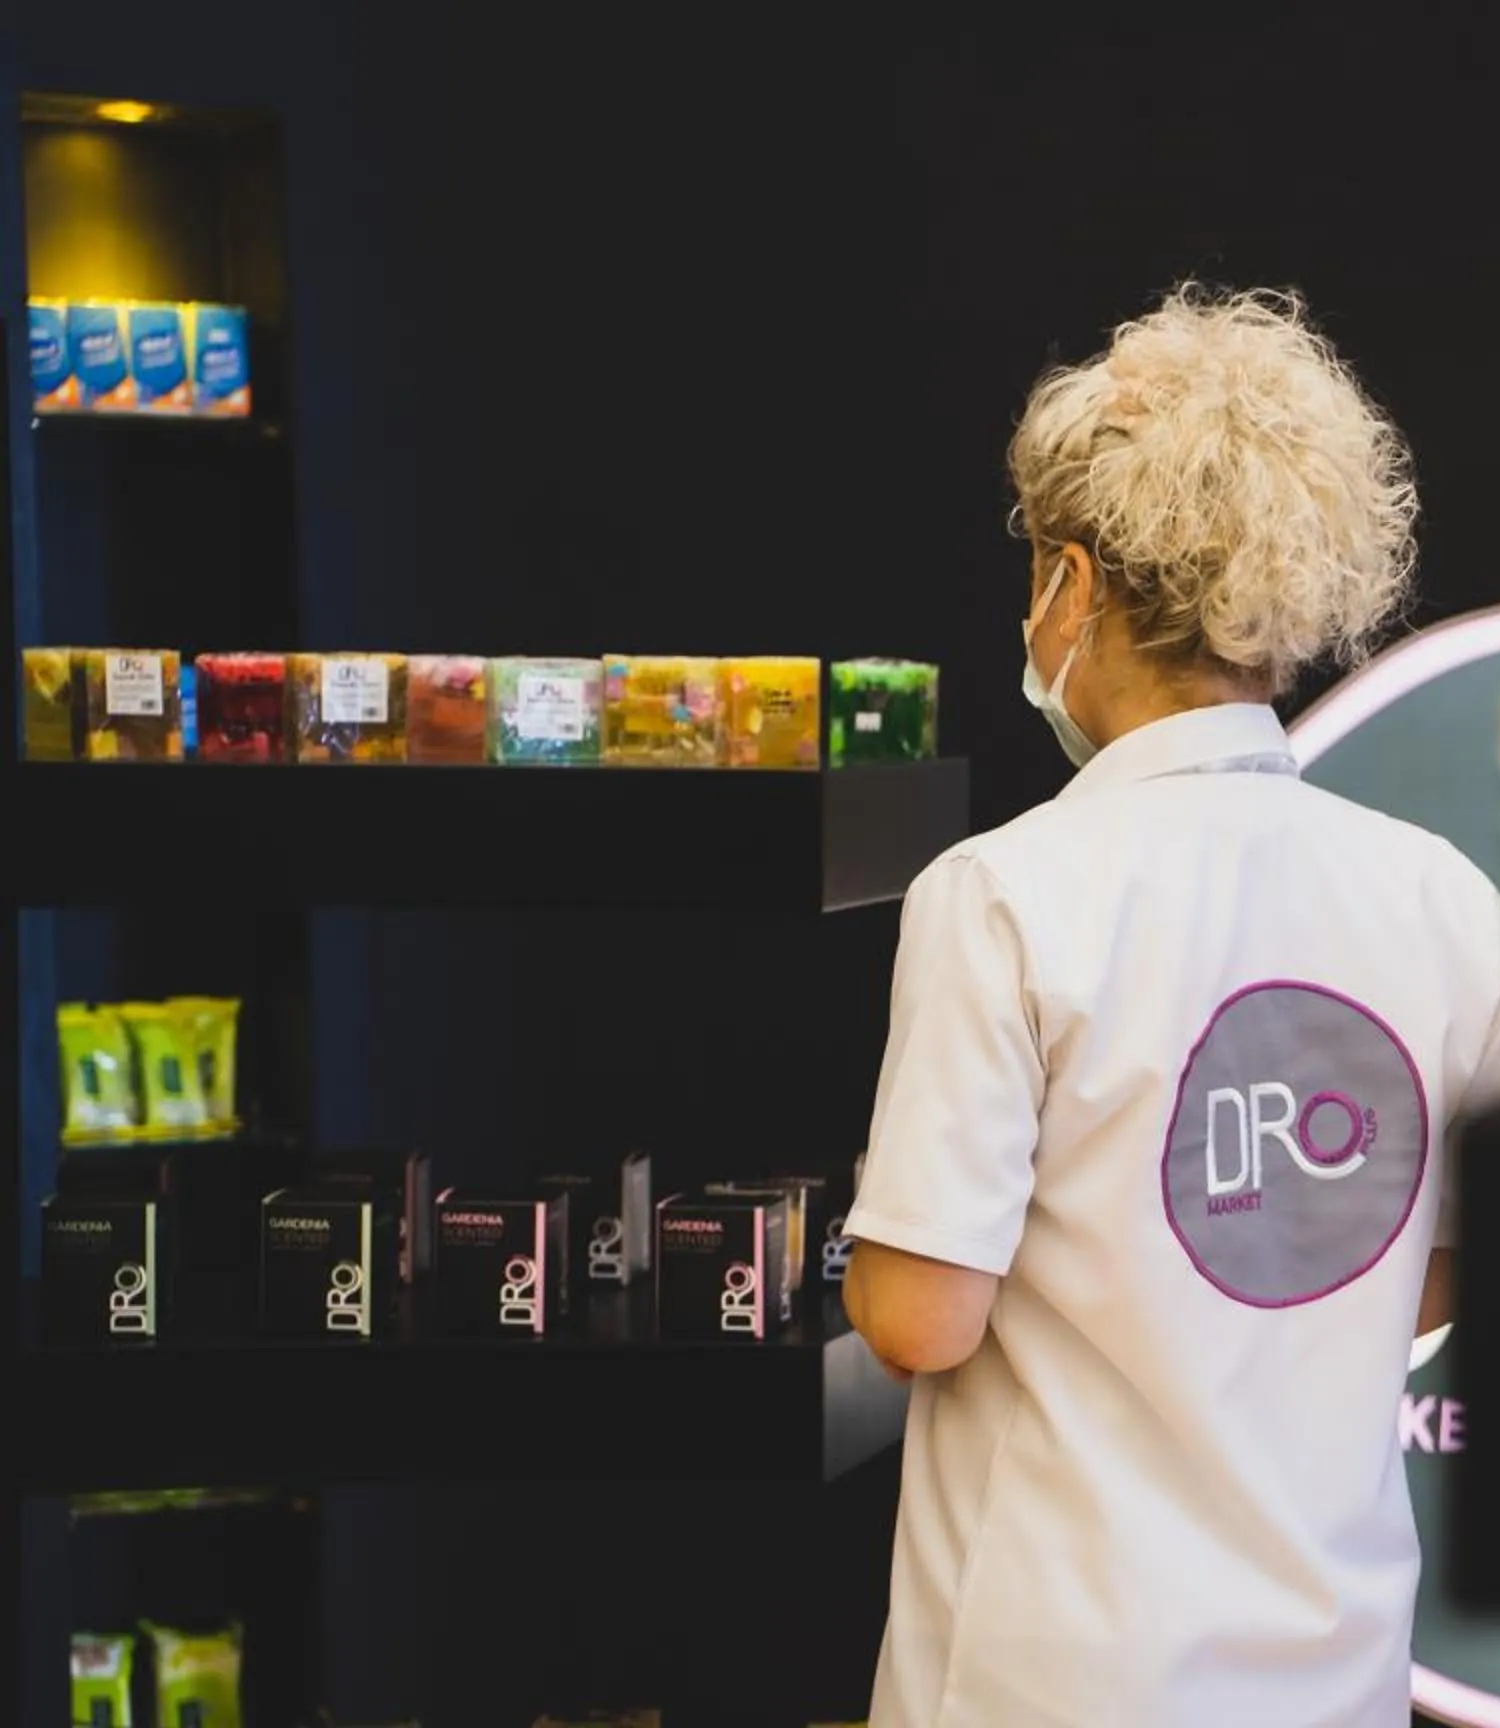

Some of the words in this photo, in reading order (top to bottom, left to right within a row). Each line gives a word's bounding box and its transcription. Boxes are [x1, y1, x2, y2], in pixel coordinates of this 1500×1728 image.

[1207, 1190, 1262, 1216] MARKET
[268, 1216, 331, 1231] GARDENIA
[440, 1212, 505, 1227] GARDENIA
[663, 1219, 724, 1233] GARDENIA
